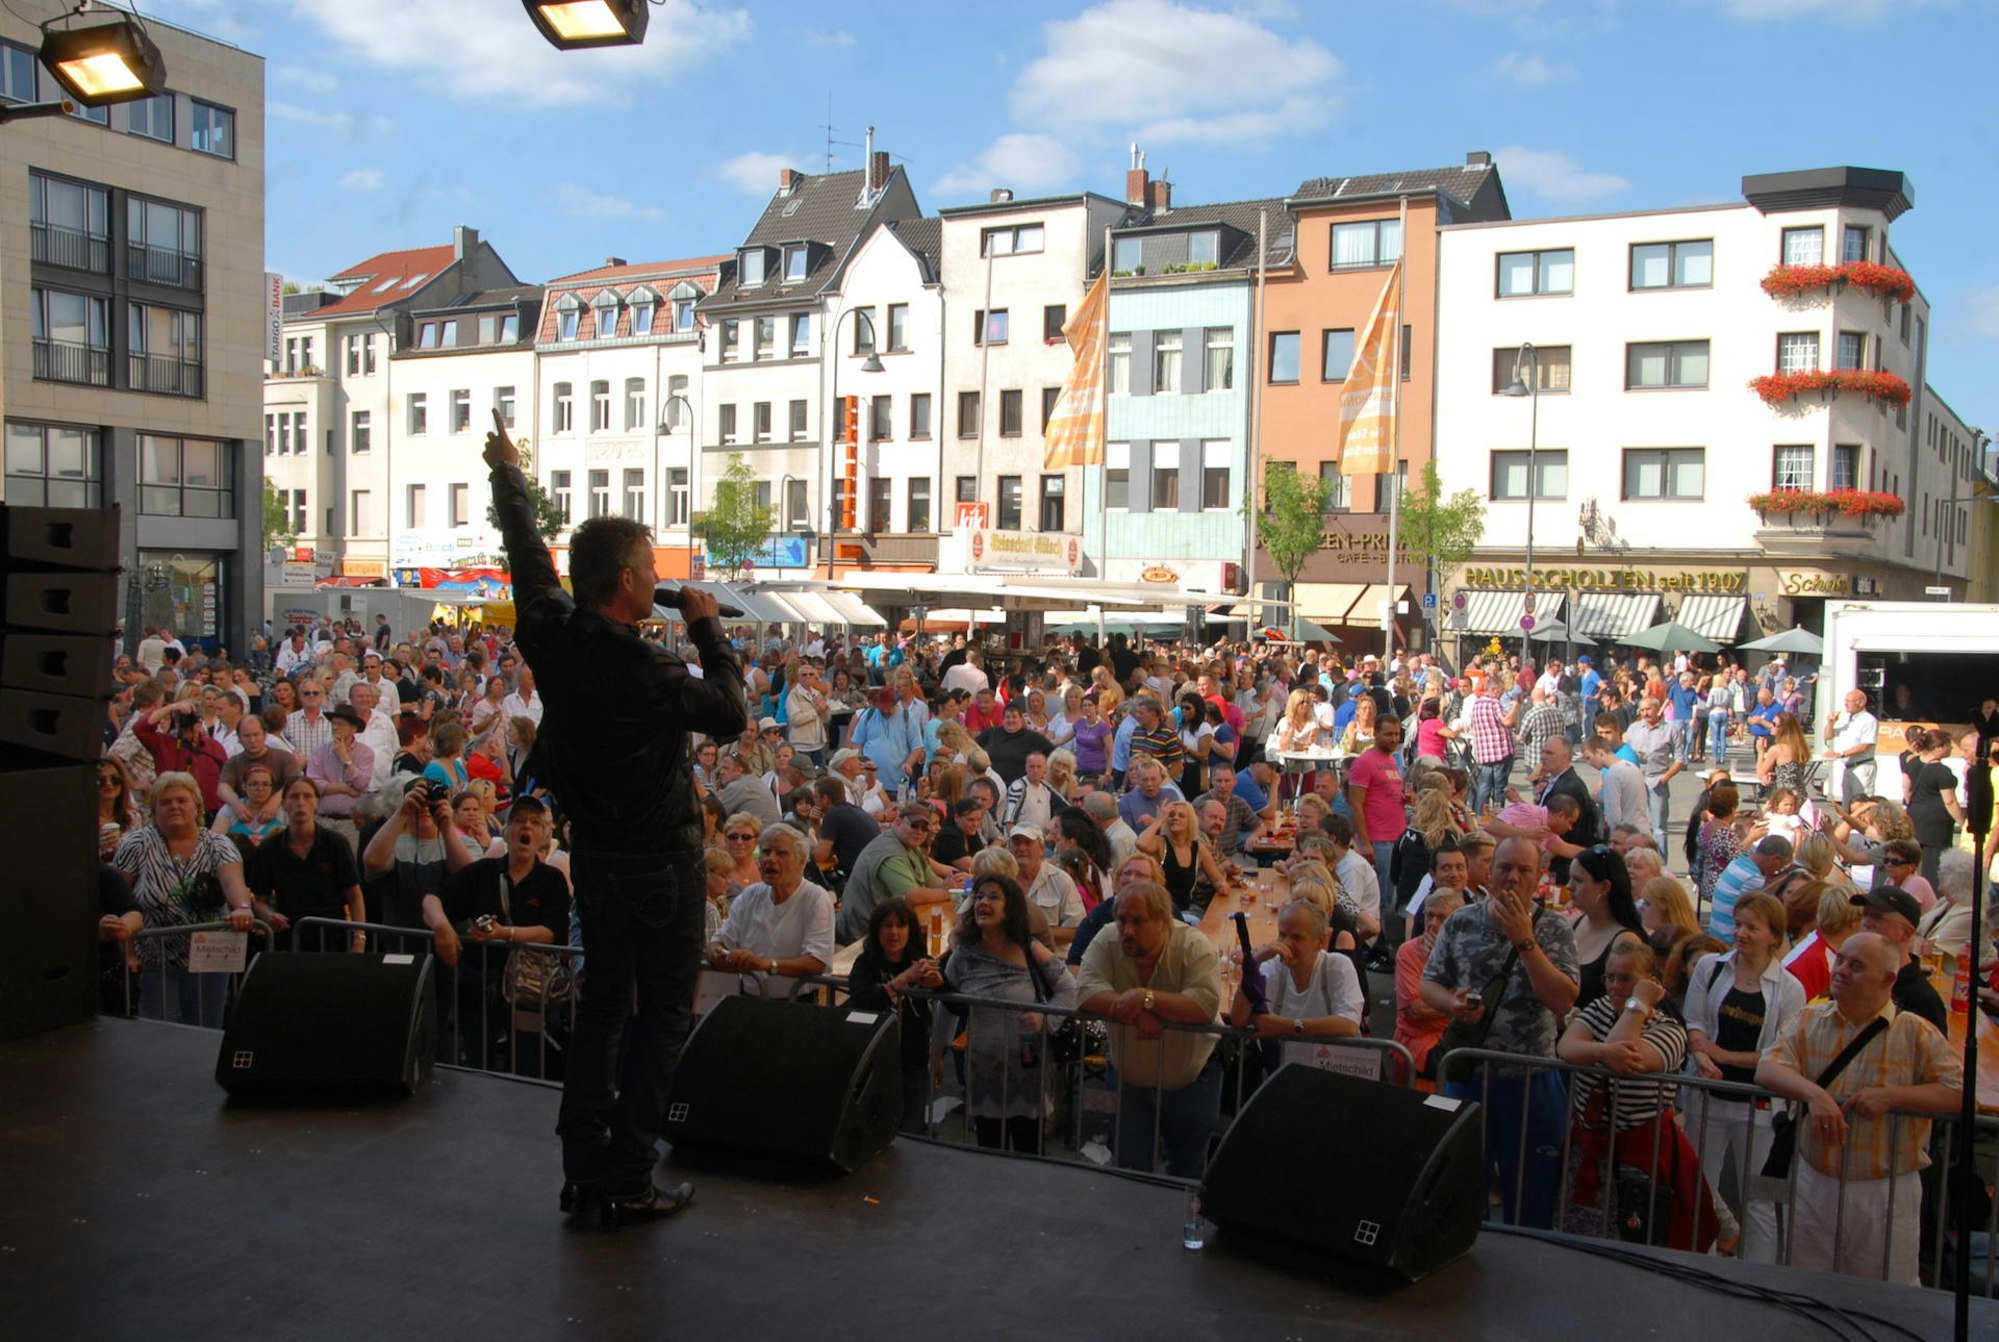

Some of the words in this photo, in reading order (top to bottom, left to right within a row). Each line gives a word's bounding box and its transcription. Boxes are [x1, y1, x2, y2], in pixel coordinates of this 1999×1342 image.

[272, 276, 281, 308] BANK
[272, 320, 281, 358] TARGO
[1465, 567, 1526, 586] HAUS
[1528, 568, 1654, 589] SCHOLZEN
[1658, 571, 1693, 589] seit
[1697, 571, 1746, 589] 1907
